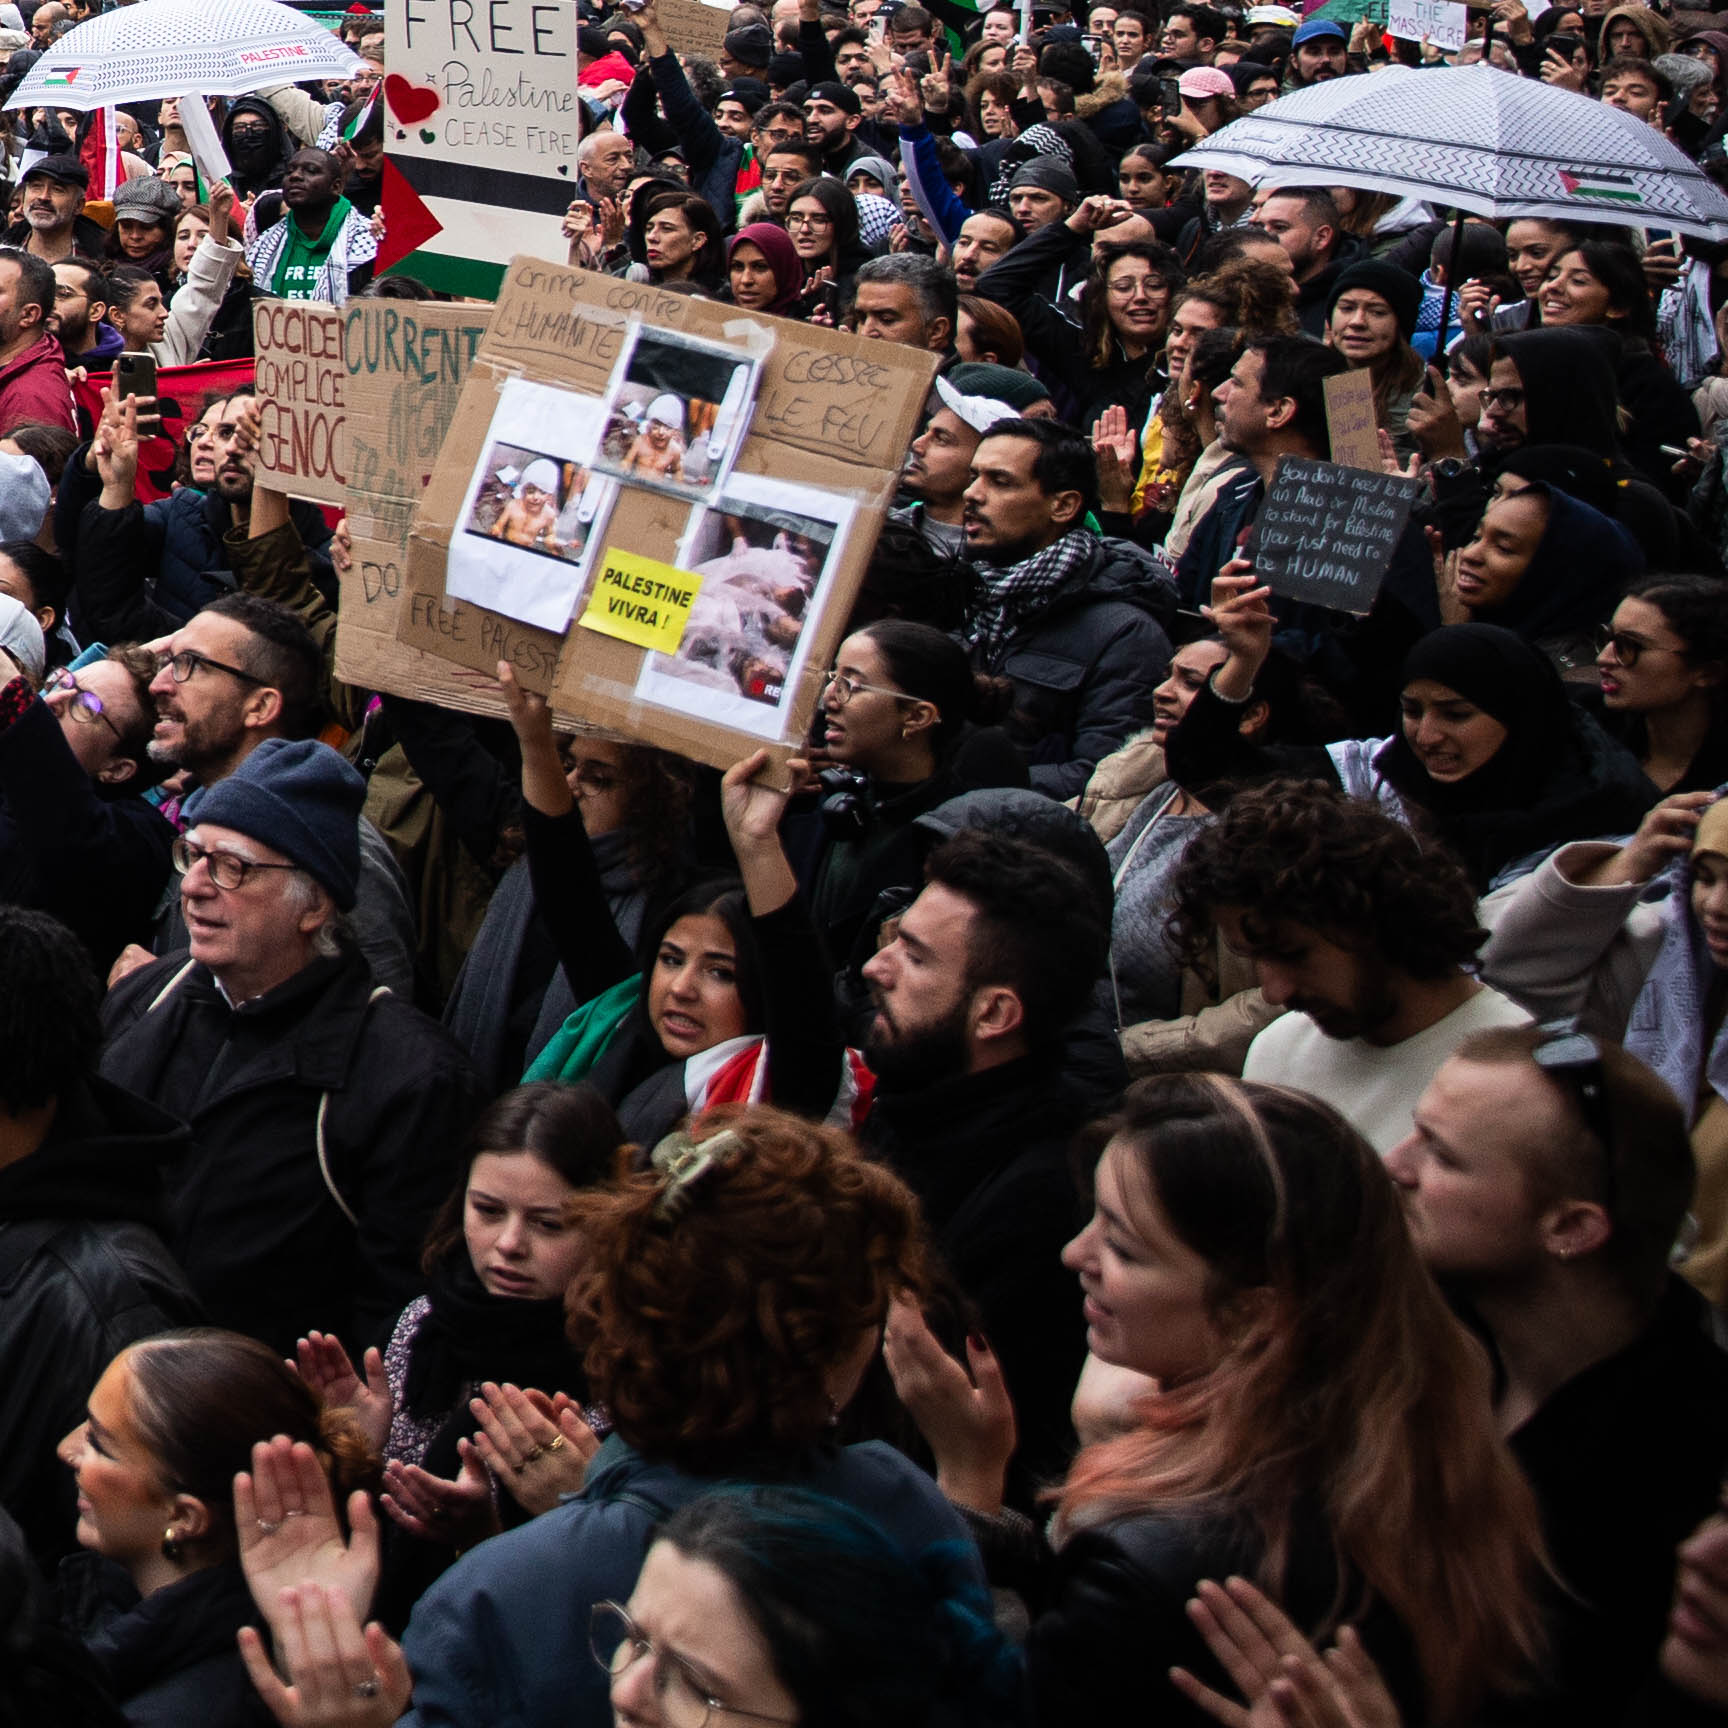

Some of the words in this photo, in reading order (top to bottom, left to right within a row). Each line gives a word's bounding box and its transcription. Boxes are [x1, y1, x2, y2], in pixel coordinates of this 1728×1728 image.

[1389, 14, 1464, 47] MASSACRE
[240, 45, 310, 64] PALESTINE
[442, 60, 574, 112] Palestine
[444, 118, 518, 148] CEASE
[526, 126, 575, 156] FIRE
[344, 306, 486, 385] CURRENT
[765, 389, 813, 428] LE
[821, 405, 885, 450] FEU
[1294, 486, 1325, 507] Arab
[1310, 466, 1346, 486] don't
[1350, 476, 1381, 493] need
[1383, 480, 1395, 496] to
[1397, 487, 1414, 501] be
[1280, 508, 1319, 525] stand
[1320, 510, 1340, 536] for
[1331, 538, 1363, 560] need
[1255, 552, 1276, 571] be
[1286, 557, 1360, 586] HUMAN
[602, 567, 693, 609] PALESTINE
[410, 591, 467, 642] FREE
[608, 595, 659, 628] VIVRA
[660, 614, 670, 630] !
